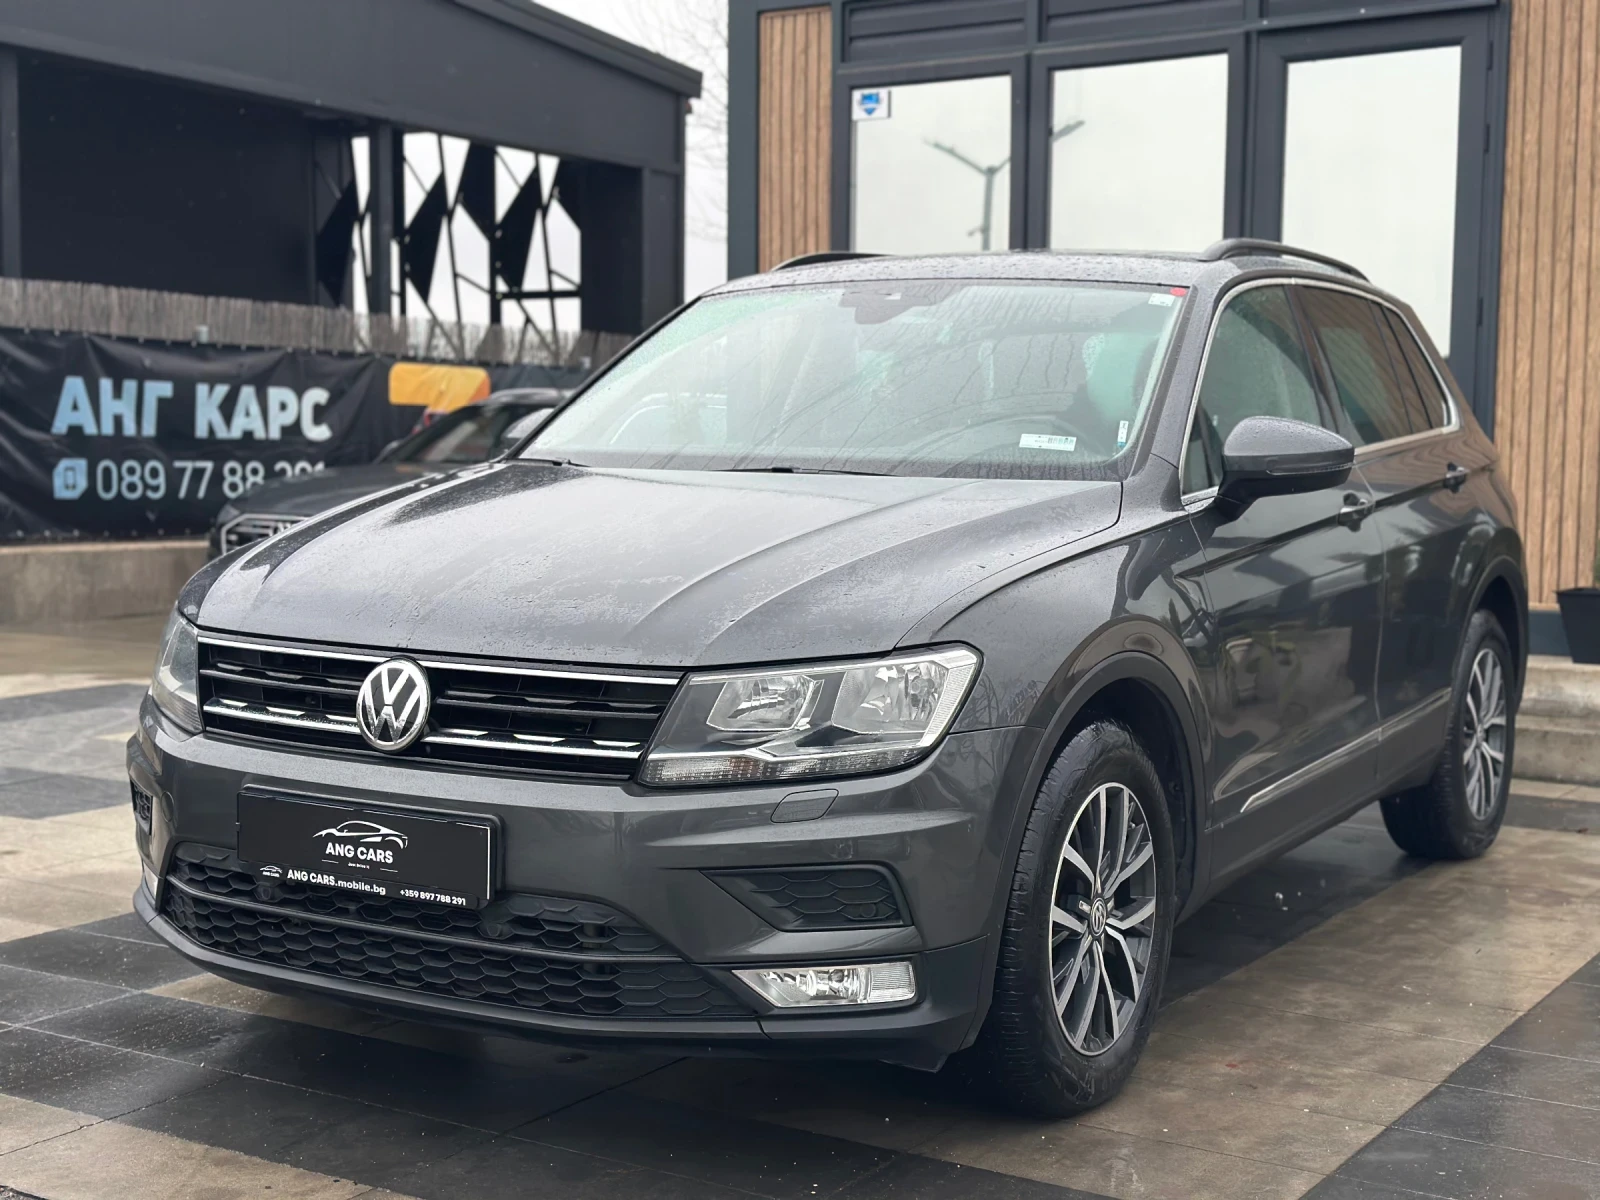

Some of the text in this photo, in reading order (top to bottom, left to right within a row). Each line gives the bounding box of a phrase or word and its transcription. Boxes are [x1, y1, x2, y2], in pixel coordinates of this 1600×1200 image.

[51, 375, 333, 442] АНГ КАРС
[96, 459, 167, 500] 089
[173, 460, 215, 499] 77
[325, 842, 394, 864] ANG CARS
[287, 868, 386, 896] ANG CARS.mobile.bg
[400, 889, 420, 899] +359
[420, 891, 435, 901] 897
[451, 896, 466, 906] 291
